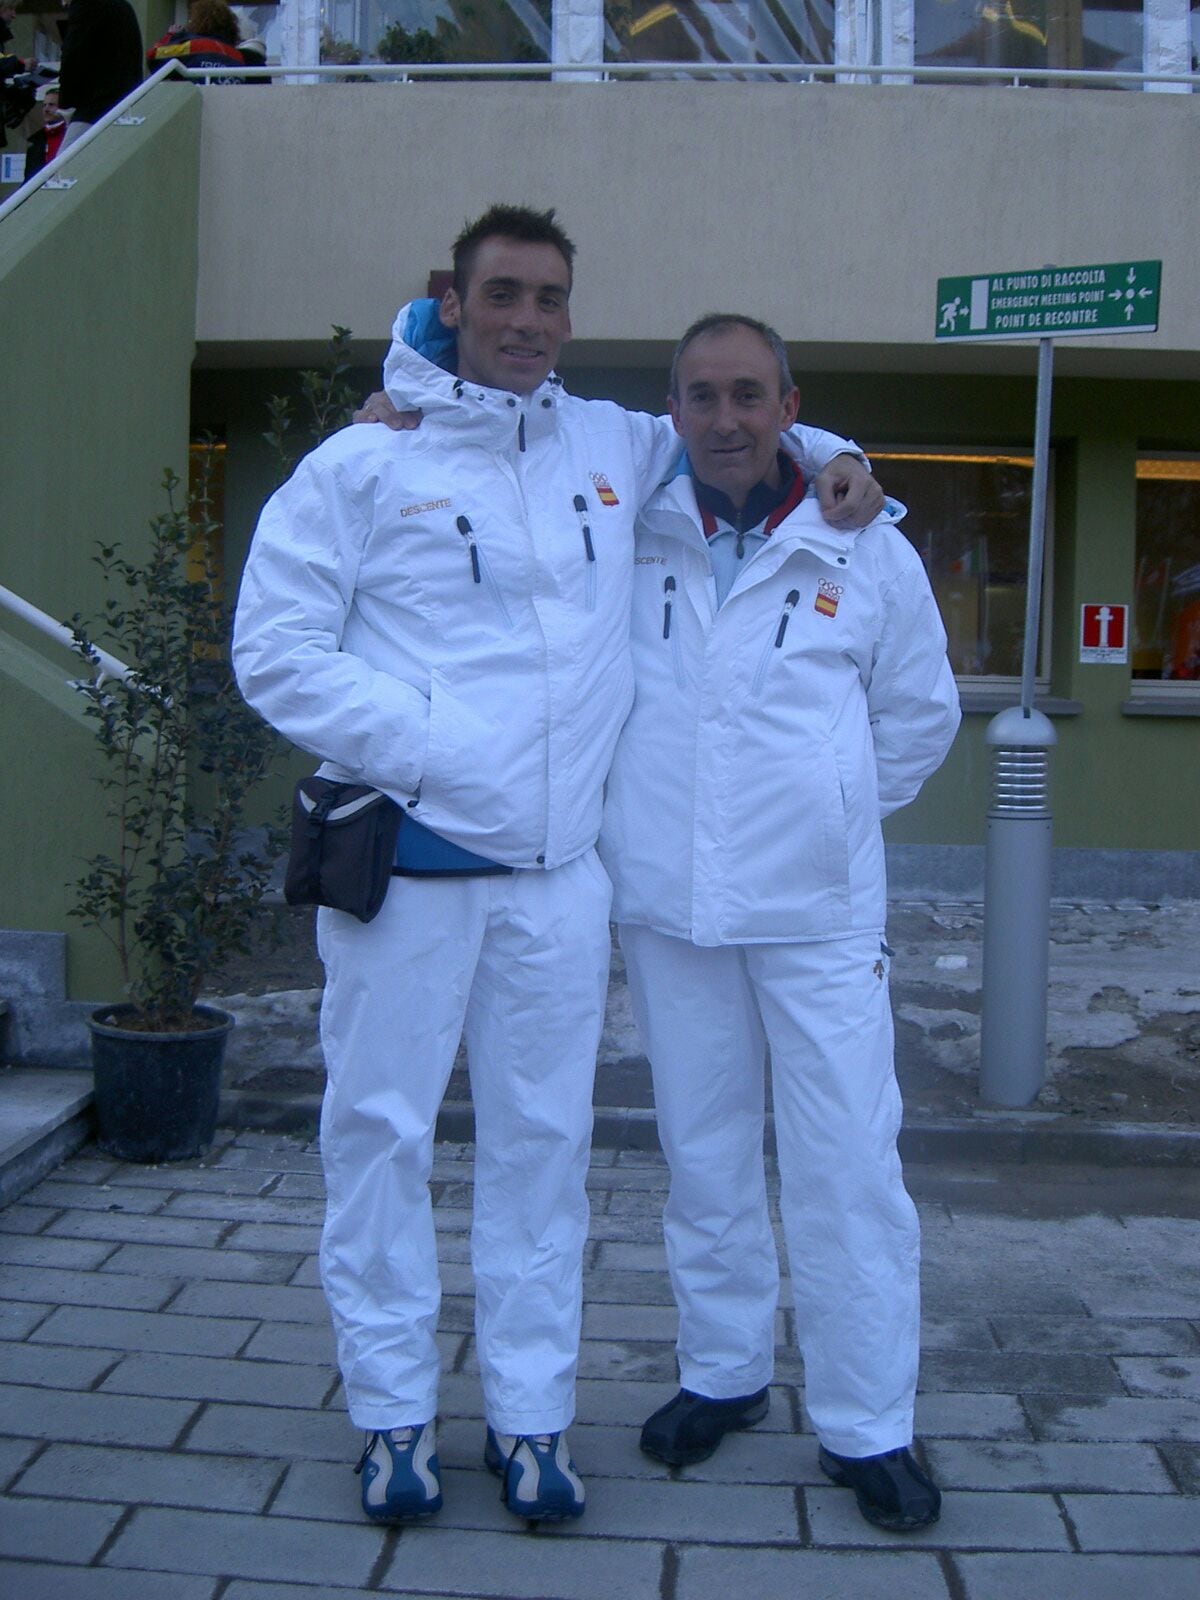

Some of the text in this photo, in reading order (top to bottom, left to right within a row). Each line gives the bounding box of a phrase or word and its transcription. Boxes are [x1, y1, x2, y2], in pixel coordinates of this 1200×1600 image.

[992, 269, 1106, 291] AL PUNTO DI RACCOLTA
[991, 289, 1105, 309] EMERGENCY MEETING POINT
[995, 308, 1098, 328] POINT DE RECONTRE
[400, 498, 452, 517] DESCENTE
[634, 555, 668, 566] SCENTE
